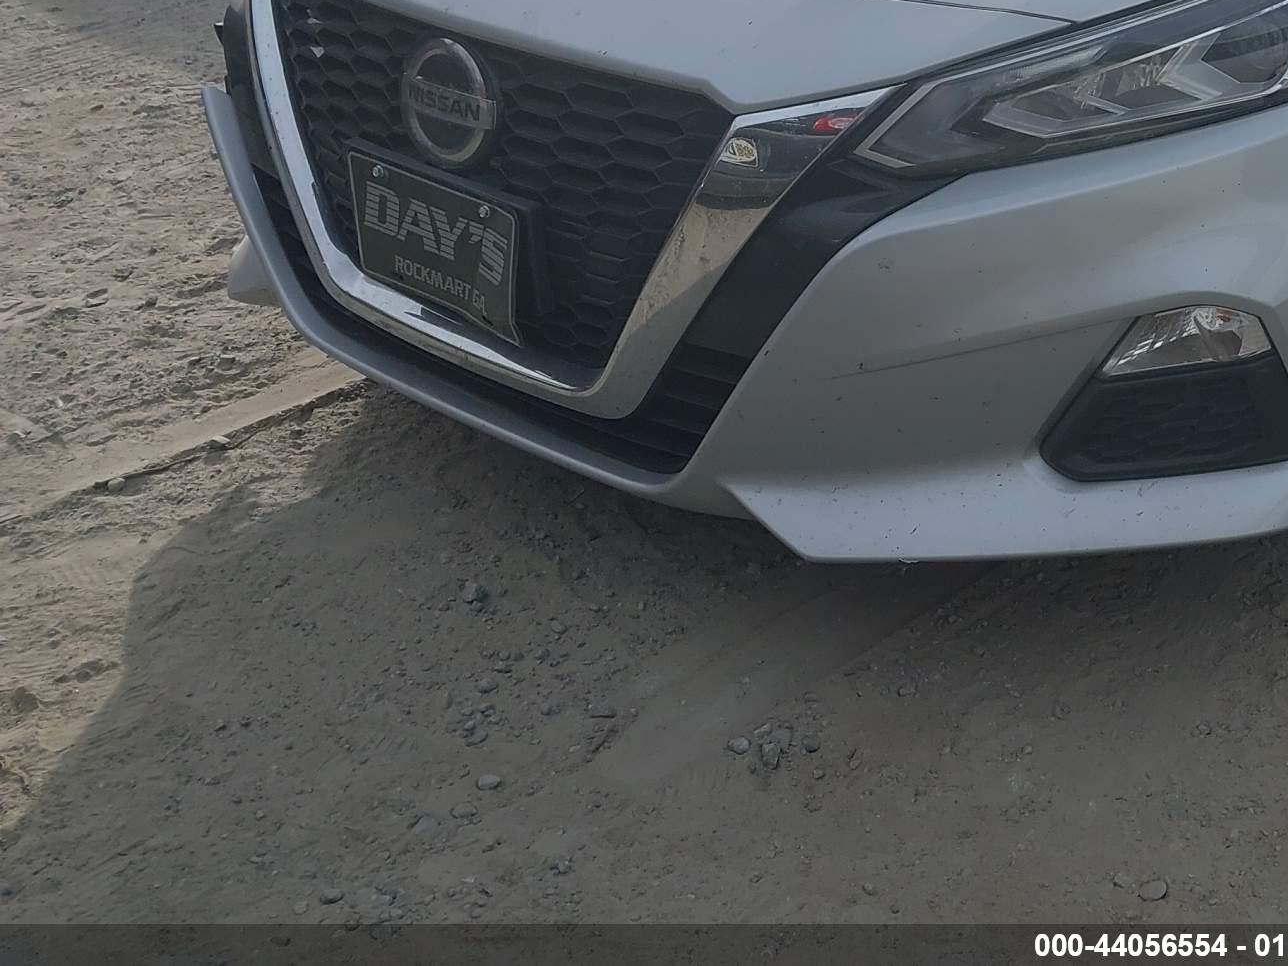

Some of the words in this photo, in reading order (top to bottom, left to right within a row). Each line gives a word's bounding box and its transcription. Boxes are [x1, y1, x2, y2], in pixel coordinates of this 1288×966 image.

[408, 85, 482, 122] NISSAN
[363, 181, 508, 286] DAY'S
[394, 254, 473, 302] ROCKMART
